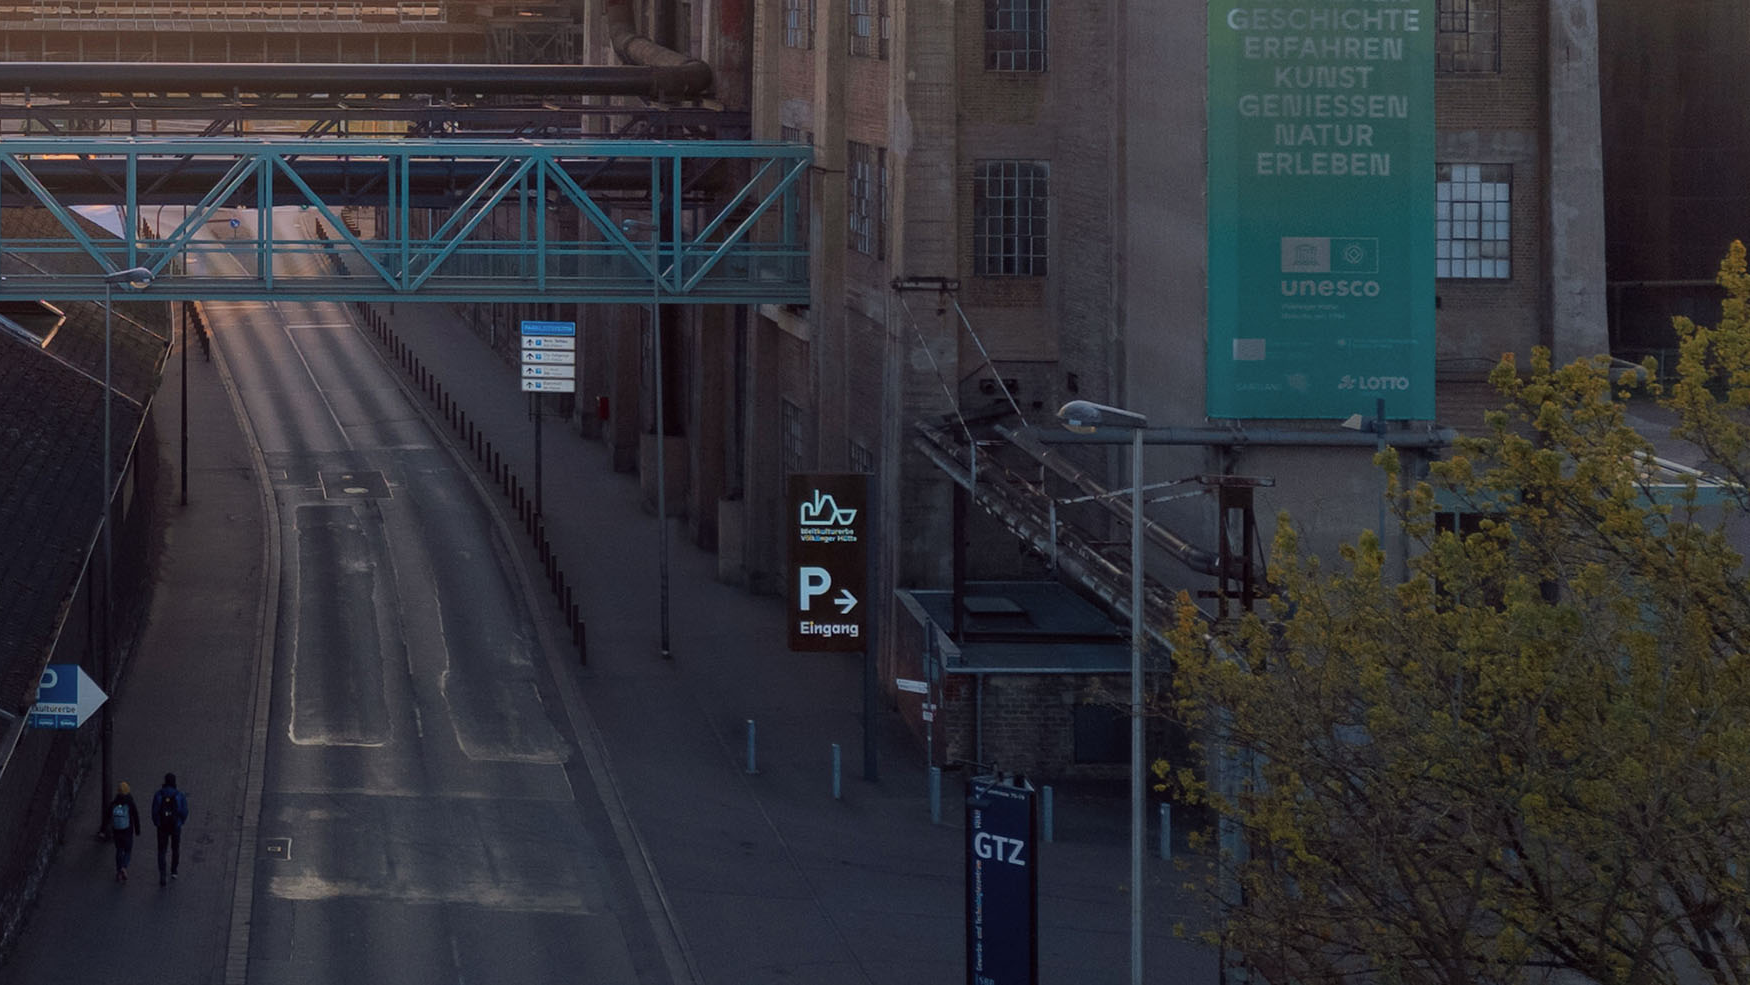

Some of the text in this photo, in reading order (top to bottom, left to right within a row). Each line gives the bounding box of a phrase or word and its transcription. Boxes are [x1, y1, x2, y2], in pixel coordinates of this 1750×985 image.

[1226, 8, 1420, 32] GESCHICHTE
[1244, 36, 1403, 60] ERFAHREN
[1274, 66, 1374, 89] KUNST
[1238, 94, 1408, 118] GENIESSEN
[1274, 124, 1374, 147] NATUR
[1256, 152, 1390, 176] ERLEBEN
[1281, 279, 1380, 297] unesco
[1359, 376, 1409, 390] LOTTO
[800, 567, 832, 611] P
[800, 621, 858, 637] Eingang
[974, 831, 1026, 866] GTZ
